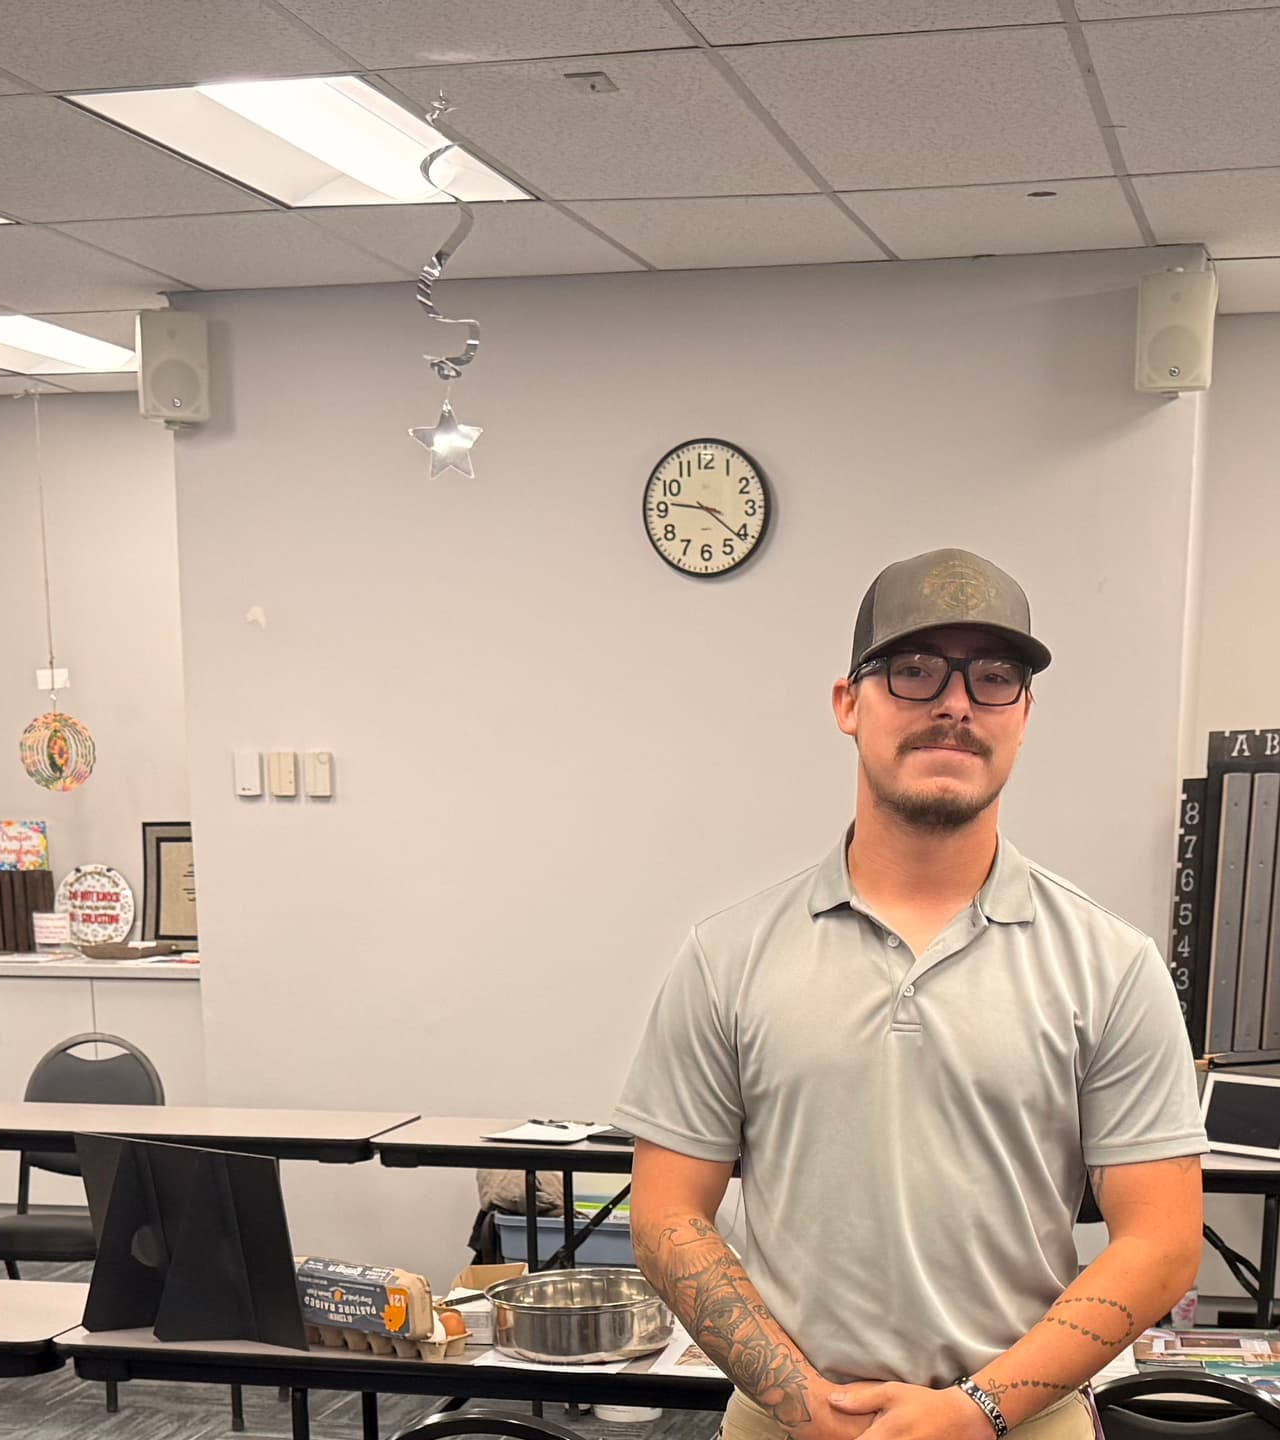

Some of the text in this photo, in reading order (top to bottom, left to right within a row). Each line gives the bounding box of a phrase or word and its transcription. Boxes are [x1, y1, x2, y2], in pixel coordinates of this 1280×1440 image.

[679, 460, 691, 477] 11
[698, 452, 715, 470] 12
[726, 459, 730, 476] 1
[663, 479, 681, 496] 10
[738, 477, 750, 494] 2
[656, 501, 669, 518] 9
[744, 500, 756, 516] 3
[664, 524, 676, 541] 8
[736, 523, 749, 540] 4
[680, 539, 691, 556] 7
[700, 544, 713, 561] 6
[722, 538, 734, 555] 5
[1231, 733, 1251, 757] A
[1265, 733, 1280, 755] B
[1185, 802, 1200, 825] 8
[1184, 835, 1199, 859] 7
[1181, 868, 1195, 892] 6
[1178, 903, 1193, 925] 5
[1177, 934, 1191, 957] 4
[1175, 968, 1190, 990] 3
[303, 1296, 336, 1312] RAISED
[337, 1304, 377, 1315] PASTURE
